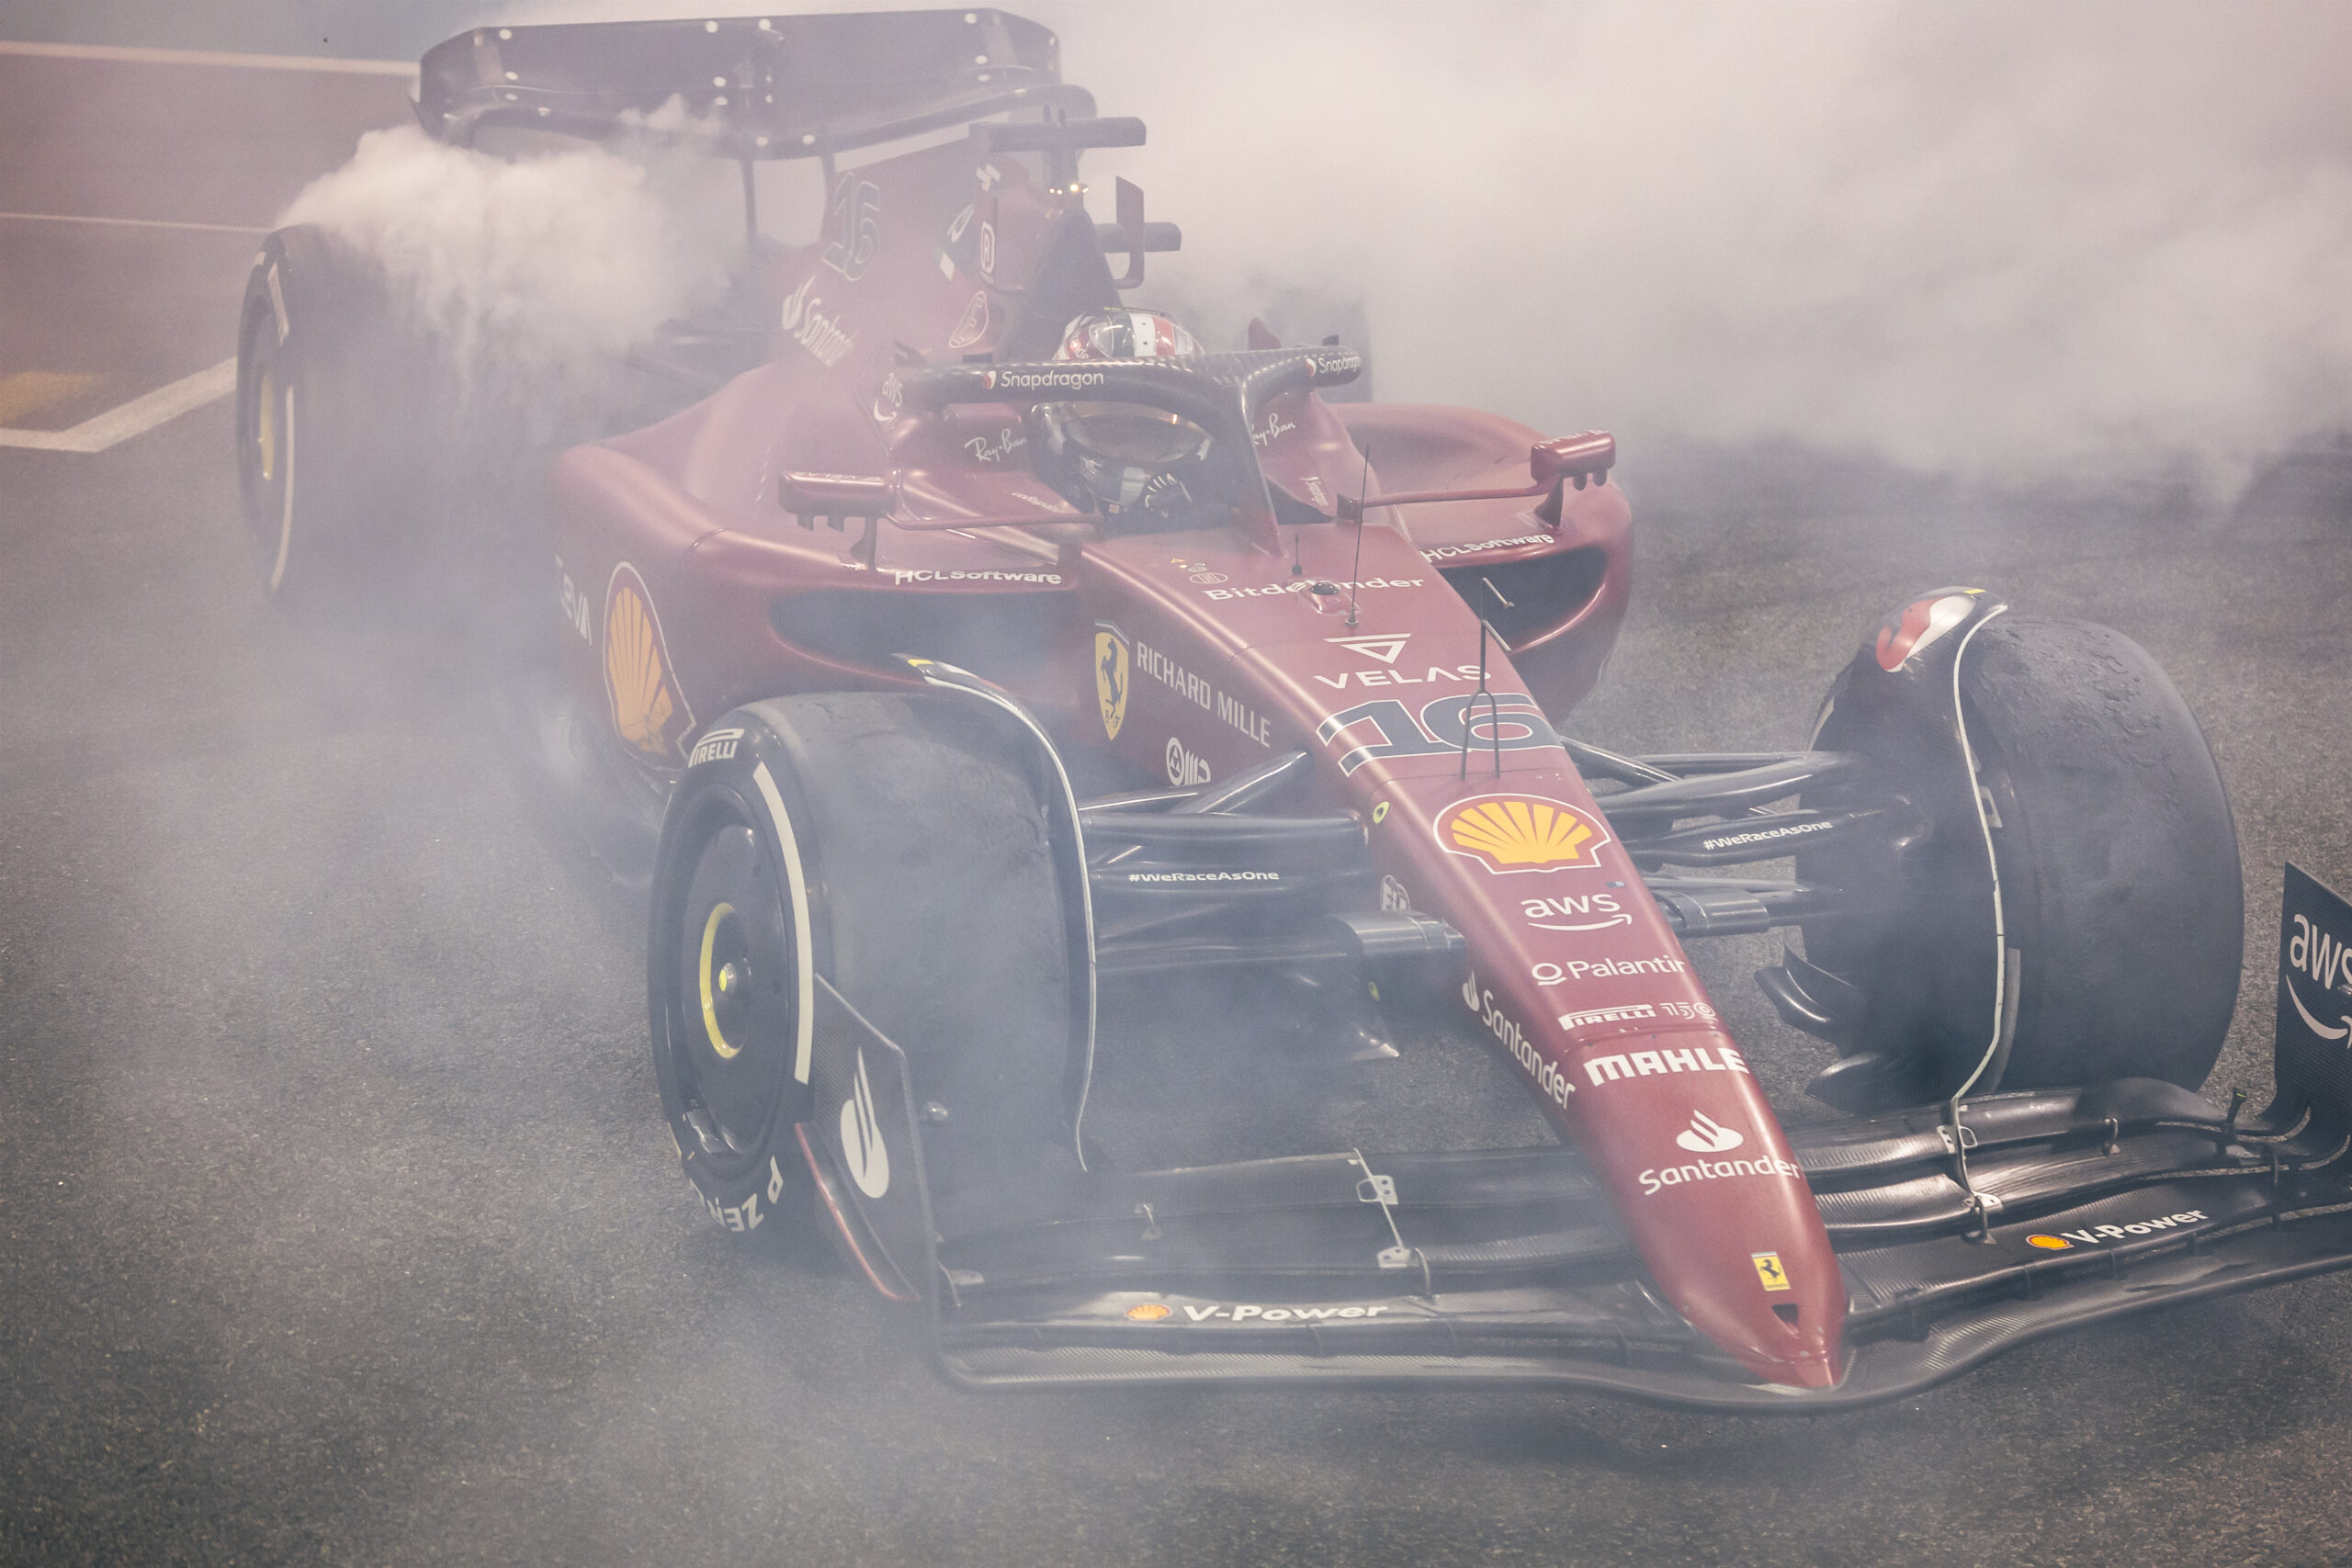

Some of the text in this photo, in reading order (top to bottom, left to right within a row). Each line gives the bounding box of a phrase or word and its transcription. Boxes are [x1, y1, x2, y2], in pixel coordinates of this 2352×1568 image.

[882, 372, 903, 408] aws
[1001, 370, 1104, 390] Snapdragon
[964, 427, 1027, 461] Ray-Ban
[1419, 533, 1555, 563] HCLSoftware
[894, 569, 1062, 585] HCLSoftware
[1202, 578, 1425, 600] Bitdender
[1314, 665, 1492, 689] VELAS
[1137, 640, 1271, 748] RICHARD MILLE
[1316, 693, 1564, 777] 16
[1702, 818, 1833, 852] #WeRaceAsOne
[1128, 871, 1280, 882] #WeRaceAsOne
[1521, 893, 1622, 918] aws
[1566, 955, 1685, 979] Palantir
[1557, 1004, 1657, 1032] PIRELLI
[1483, 989, 1576, 1110] Santander
[1583, 1047, 1749, 1088] MAHLE
[1639, 1155, 1801, 1196] Santander
[2062, 1208, 2210, 1247] V-Power
[1182, 1303, 1388, 1323] V-Power
